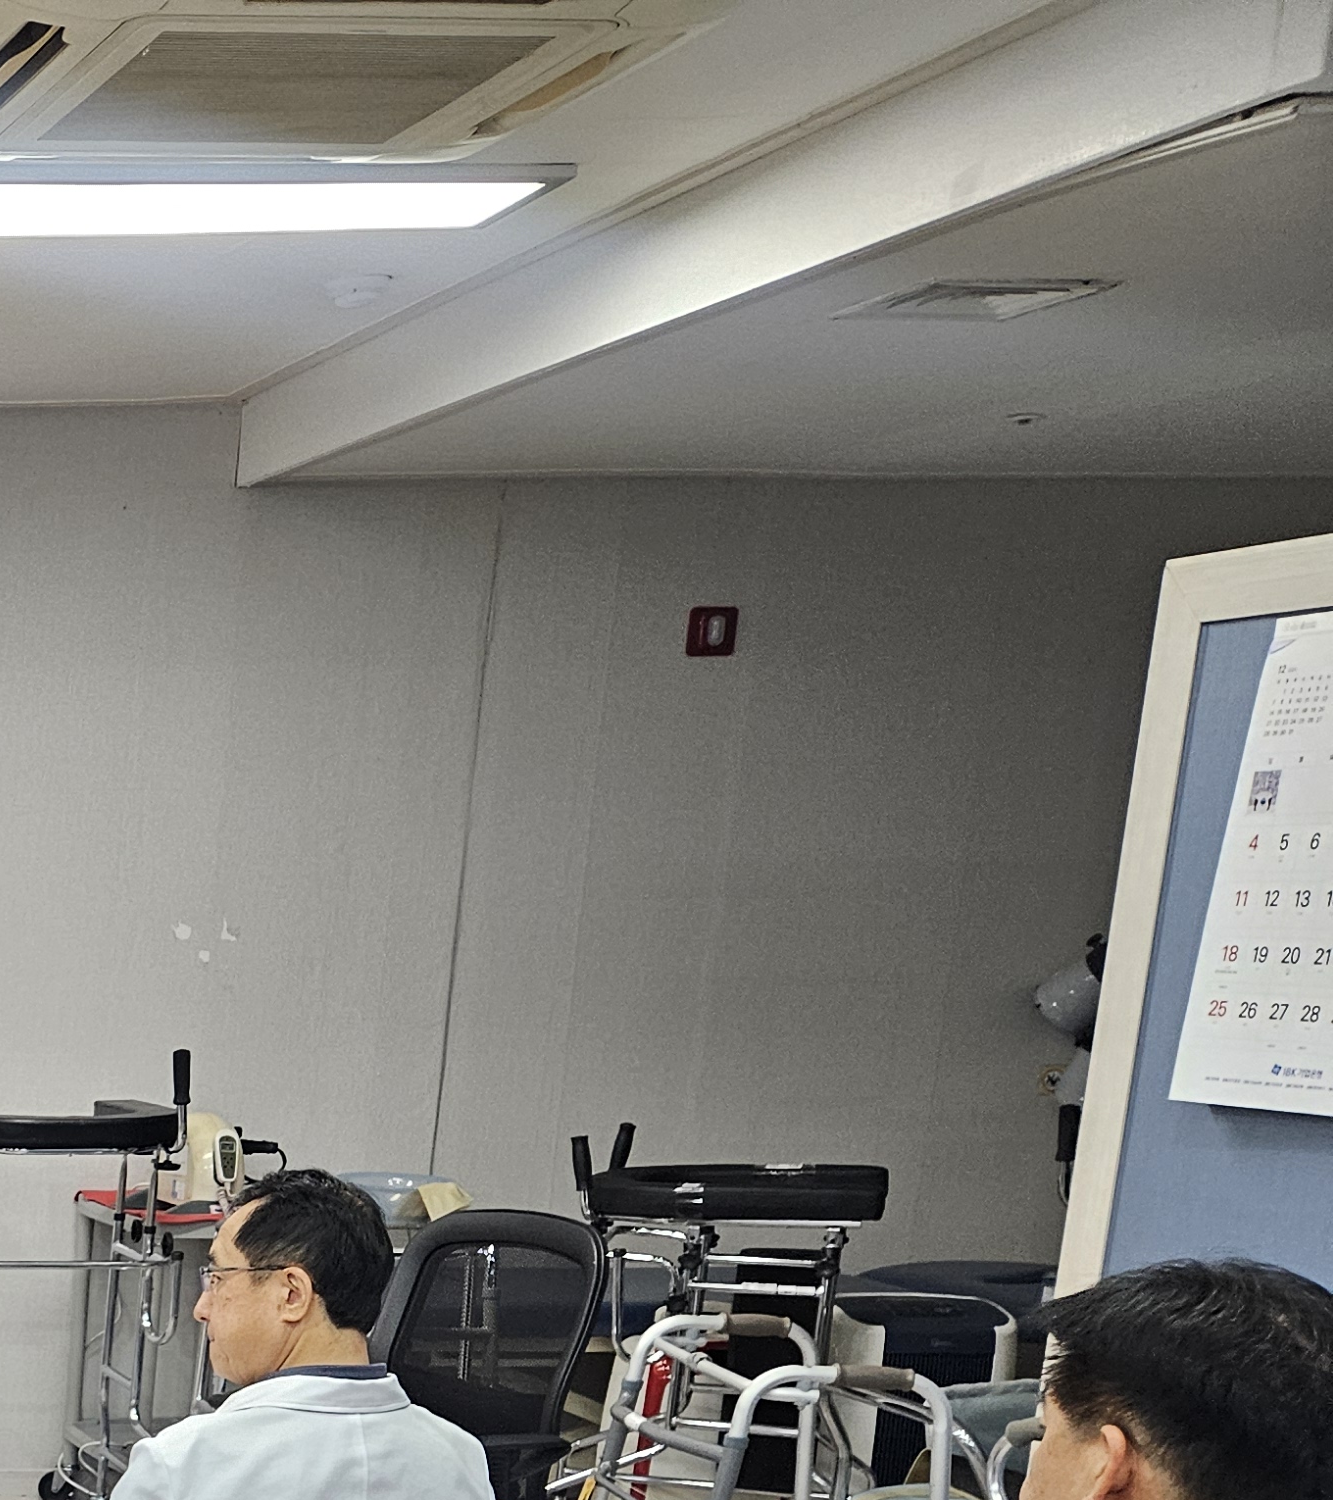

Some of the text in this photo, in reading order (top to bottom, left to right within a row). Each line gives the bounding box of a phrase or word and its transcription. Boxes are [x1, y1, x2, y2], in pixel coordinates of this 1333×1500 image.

[1248, 832, 1321, 851] 4 5 6
[1235, 890, 1249, 907] 11
[1264, 890, 1280, 907] 12
[1295, 890, 1311, 908] 13
[1222, 945, 1332, 965] 18 19 20 21
[1208, 1000, 1321, 1023] 25 26 27 28
[1283, 1067, 1297, 1077] IBK
